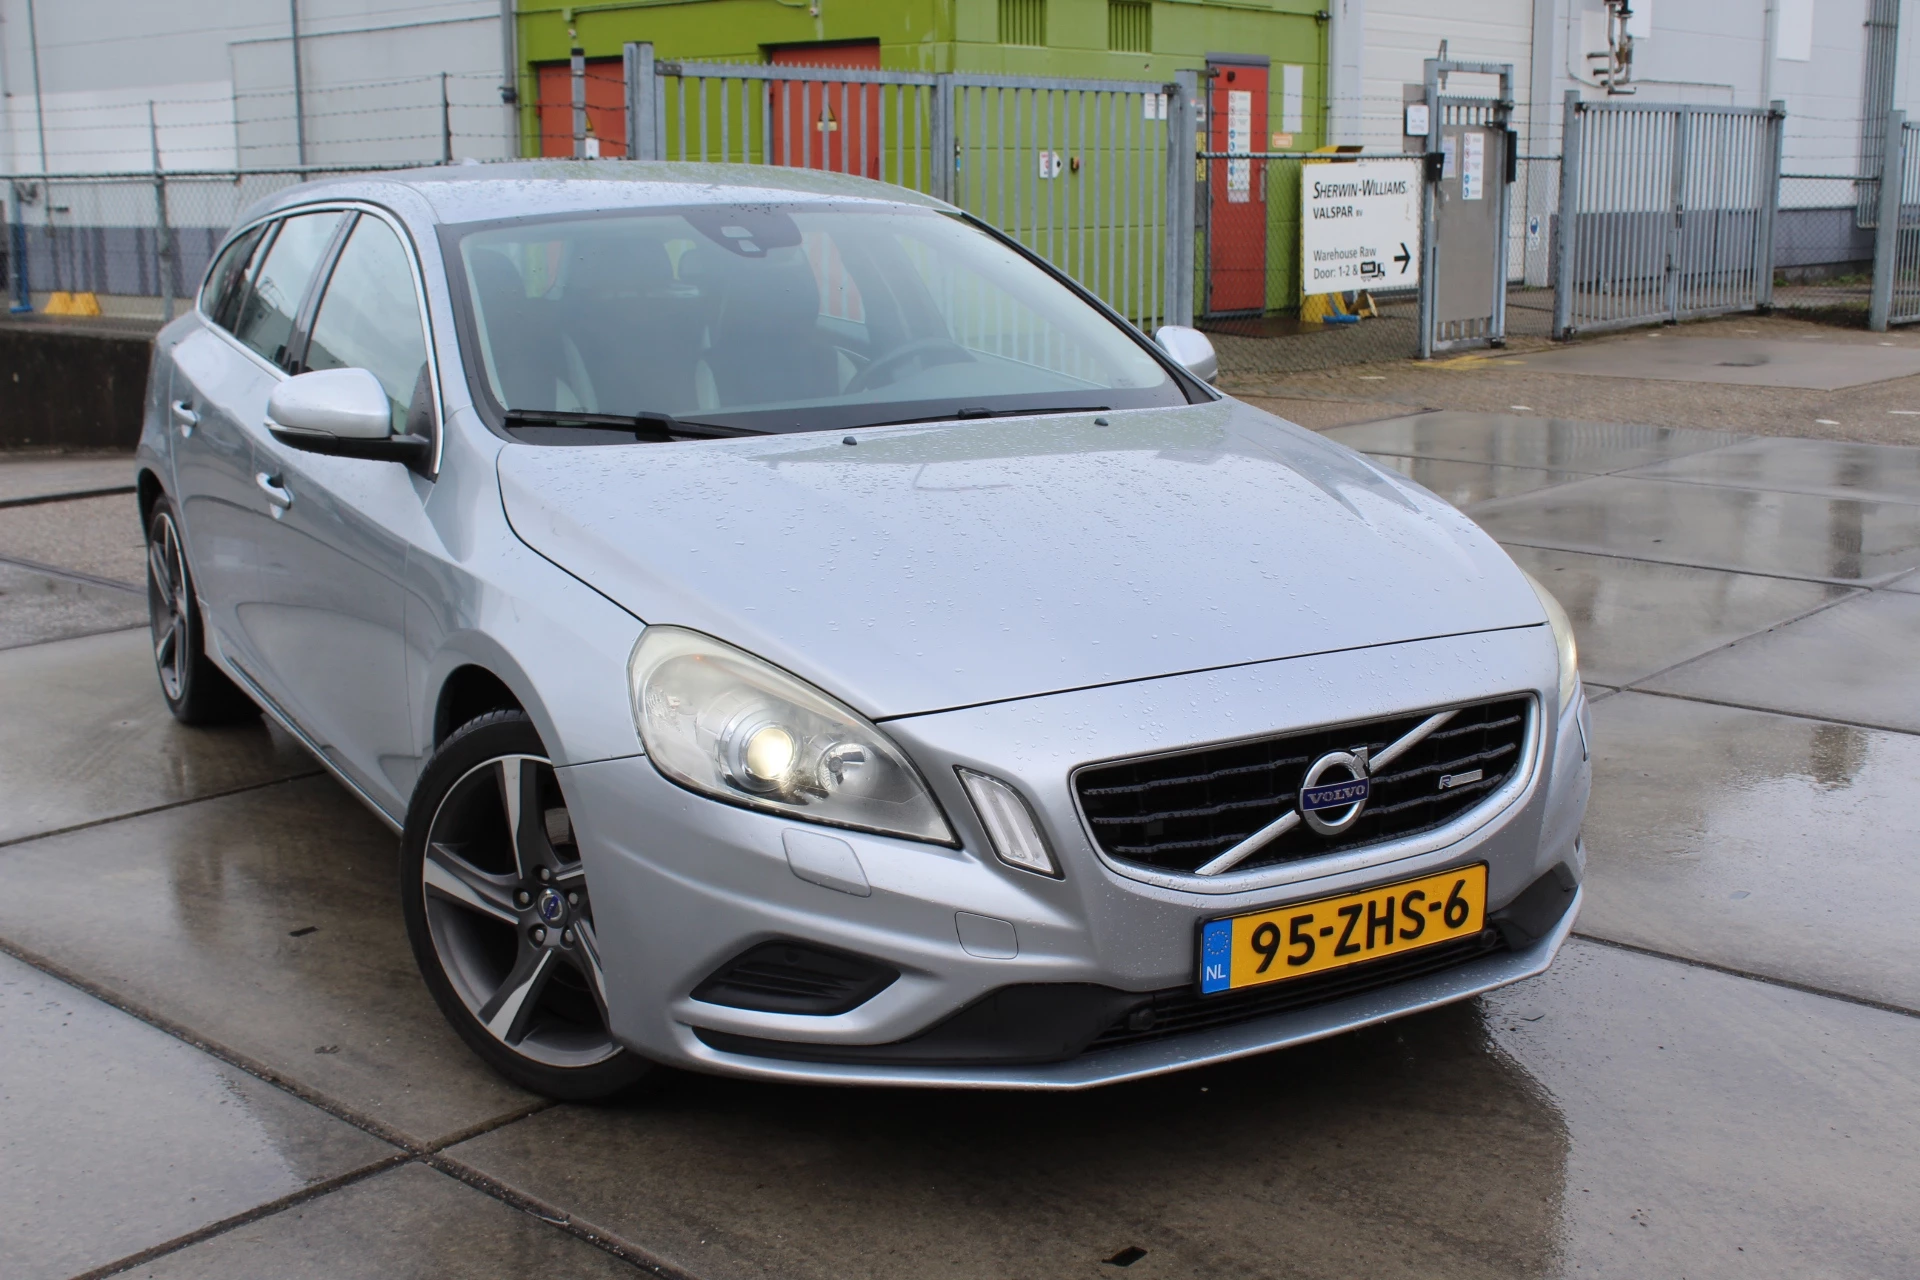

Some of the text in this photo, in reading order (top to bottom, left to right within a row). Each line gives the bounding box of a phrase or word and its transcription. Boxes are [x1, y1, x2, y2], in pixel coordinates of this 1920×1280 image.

[1313, 205, 1353, 220] VALSPAR
[1313, 246, 1377, 262] Warehouse Raw
[1313, 266, 1336, 280] Door:
[1339, 265, 1350, 277] 1-2
[1352, 264, 1359, 276] &
[1307, 784, 1366, 804] VOLVO
[1251, 879, 1470, 974] 95-ZHS-6
[1206, 964, 1226, 981] NL
